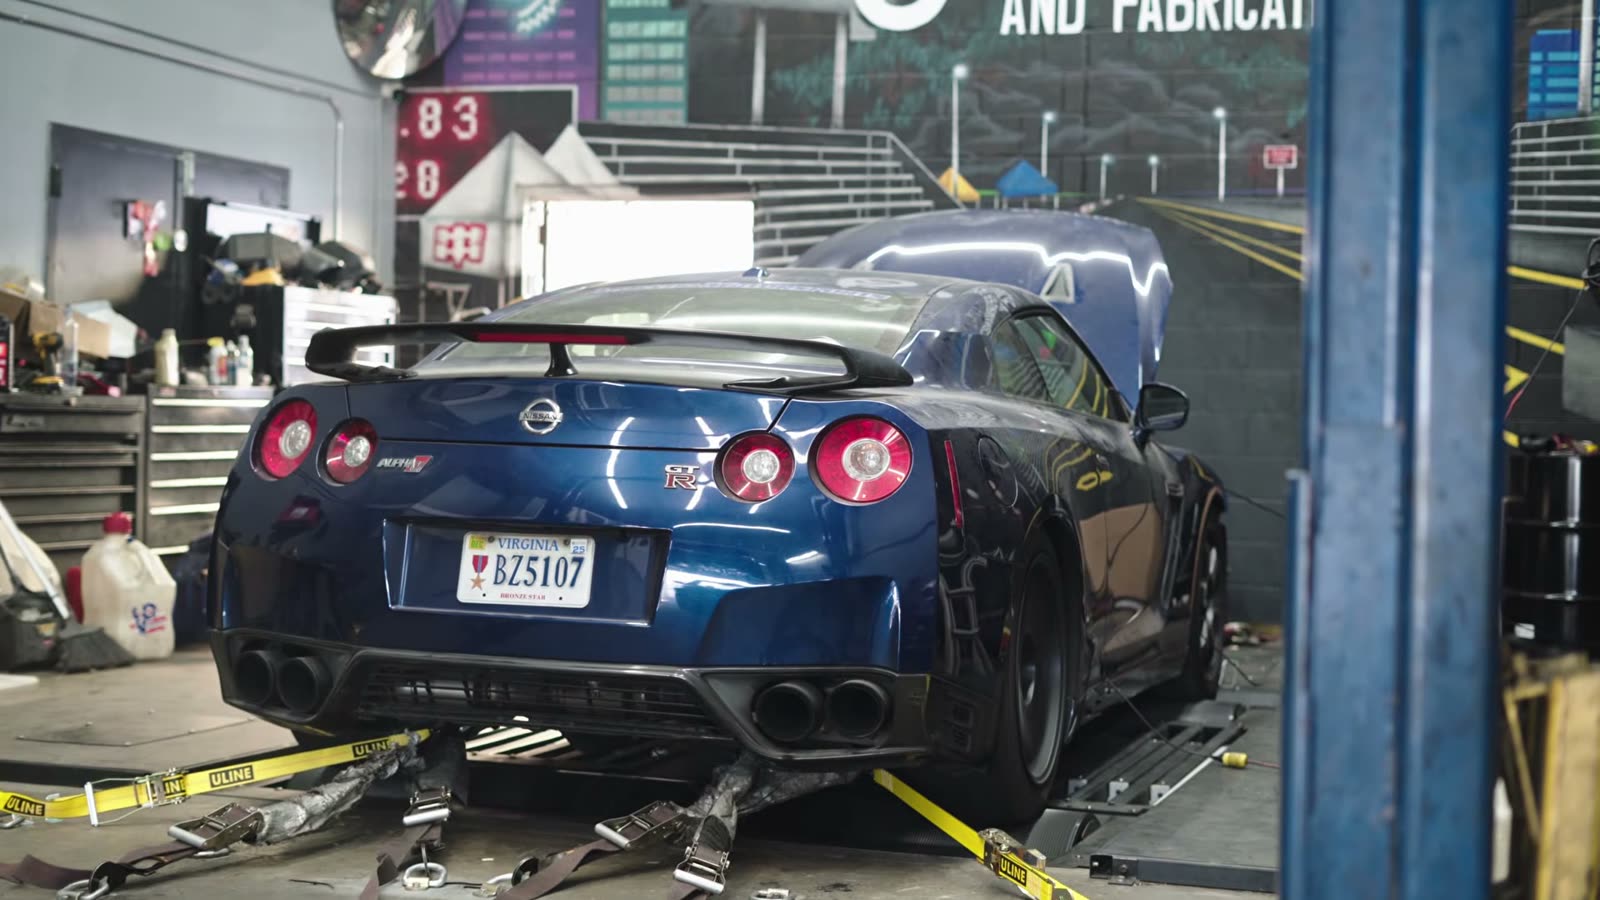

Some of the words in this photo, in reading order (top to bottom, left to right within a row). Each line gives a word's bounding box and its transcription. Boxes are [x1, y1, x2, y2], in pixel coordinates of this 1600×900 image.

[1000, 0, 1087, 35] AND
[1112, 0, 1314, 33] FABRICAT
[523, 411, 557, 420] NISSAN
[664, 464, 701, 474] GT
[664, 473, 698, 490] R
[498, 537, 559, 552] VIRGINIA
[572, 545, 585, 555] 25
[493, 554, 585, 588] BZ5107
[211, 767, 253, 787] ULINE
[6, 797, 44, 815] ULINE
[1001, 858, 1026, 884] ULINE
